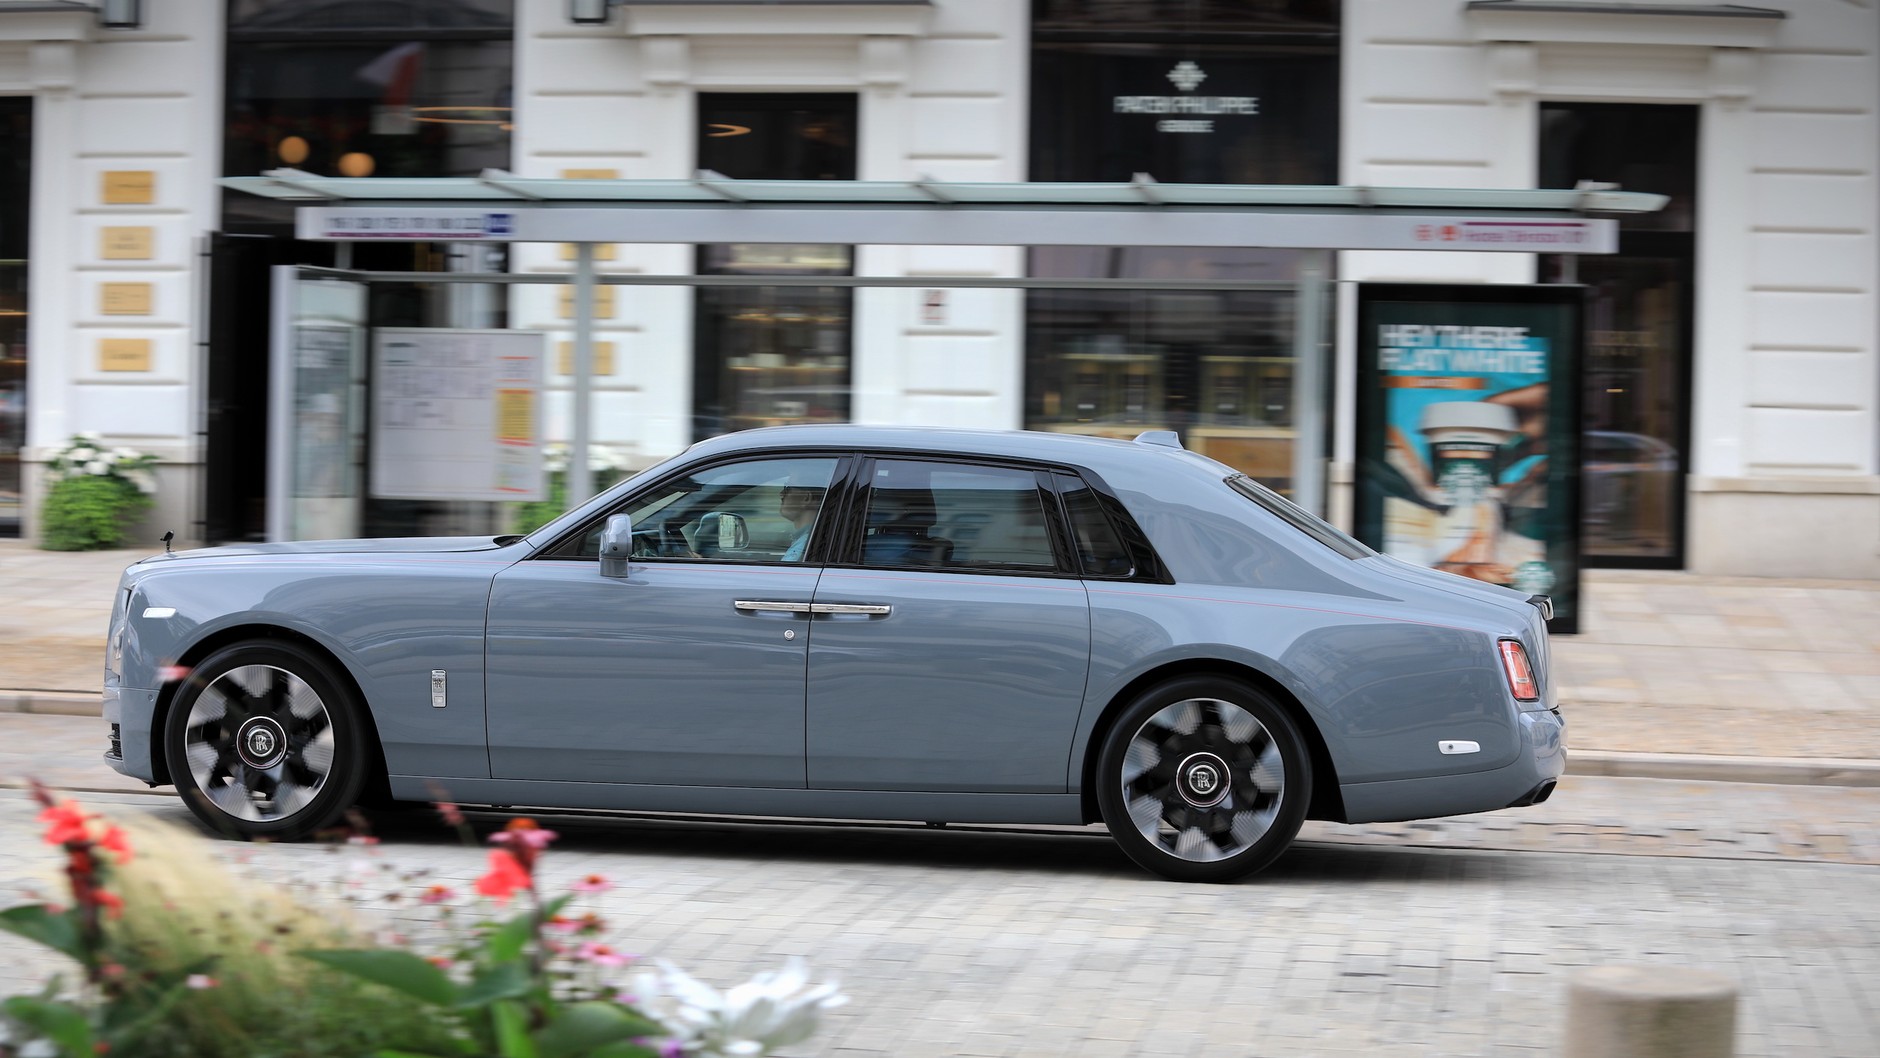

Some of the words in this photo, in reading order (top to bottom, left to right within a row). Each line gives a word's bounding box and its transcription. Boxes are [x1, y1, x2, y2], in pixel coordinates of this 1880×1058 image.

[1174, 96, 1260, 115] PHILIPPE
[1378, 324, 1436, 348] HEY
[1436, 326, 1530, 350] THERE
[1377, 348, 1448, 371] FLAT
[1448, 350, 1546, 374] WHITE
